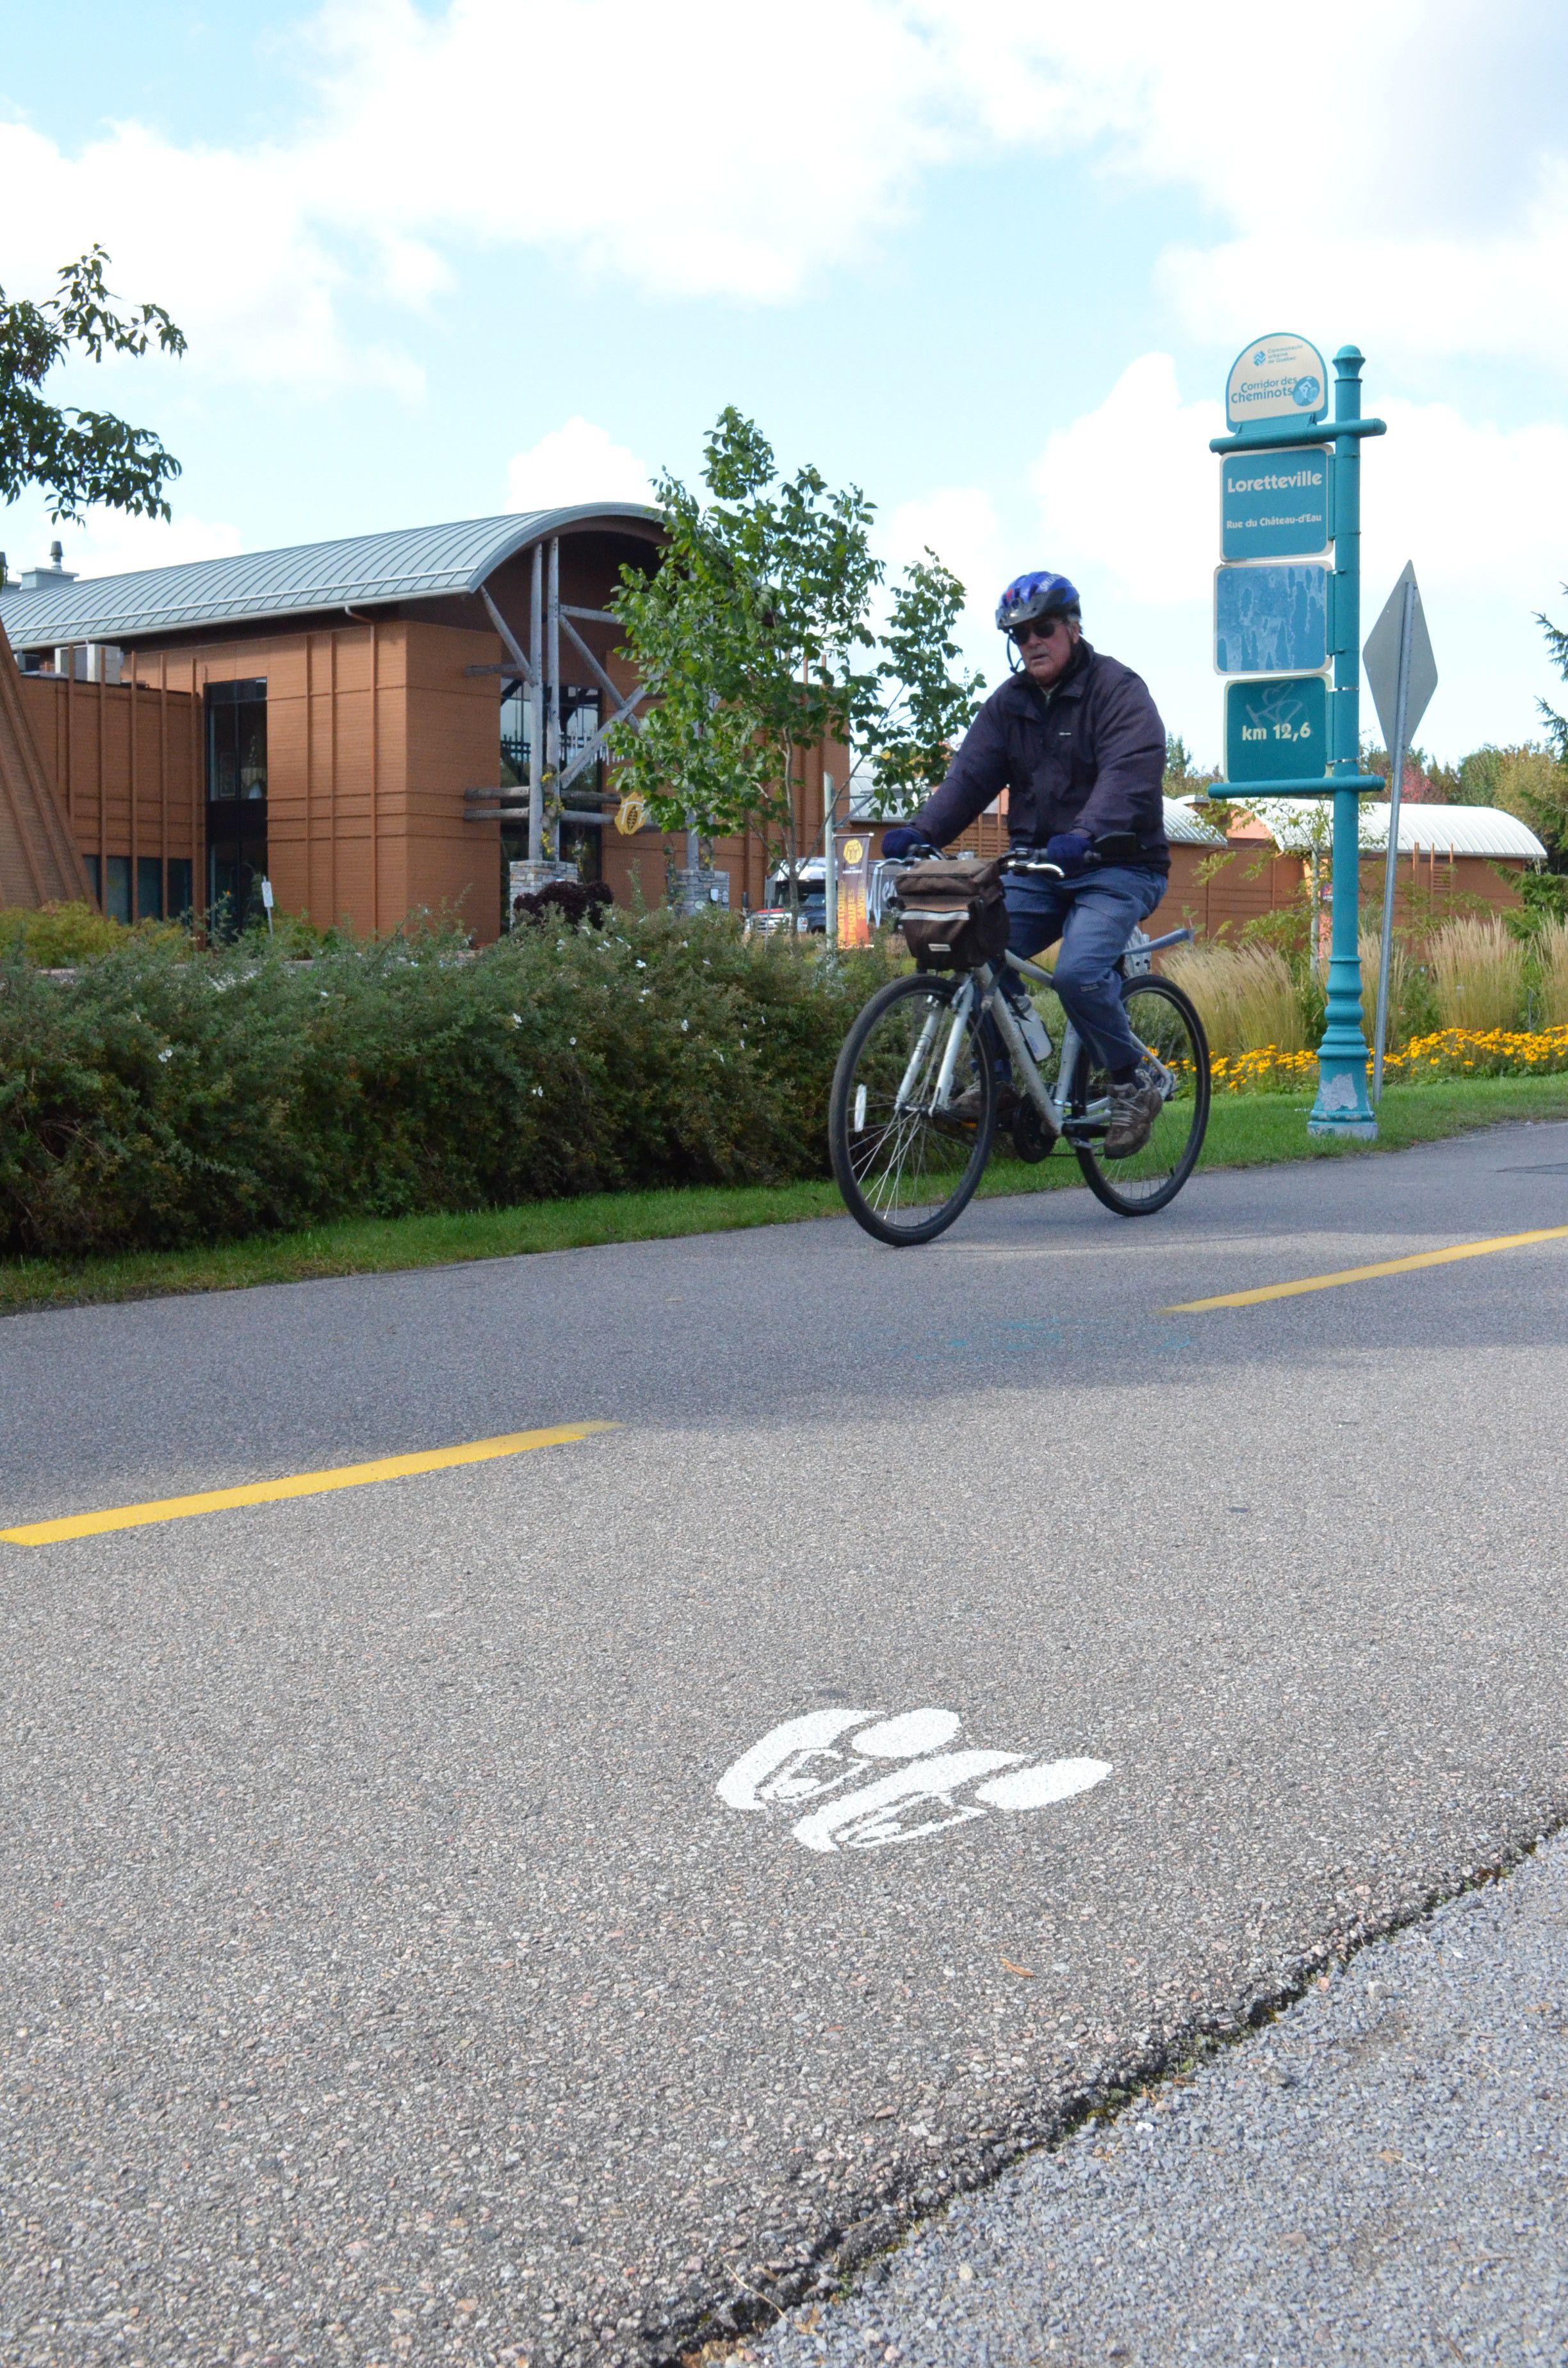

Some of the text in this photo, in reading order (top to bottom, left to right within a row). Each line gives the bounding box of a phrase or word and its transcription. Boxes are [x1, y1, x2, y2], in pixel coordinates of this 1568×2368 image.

[1241, 377, 1297, 393] Corridor des
[1231, 387, 1293, 404] Cheminots
[1227, 470, 1323, 493] Loretteville
[1227, 513, 1321, 529] Rue du Château-d'Eau
[1242, 722, 1311, 742] km 12,6
